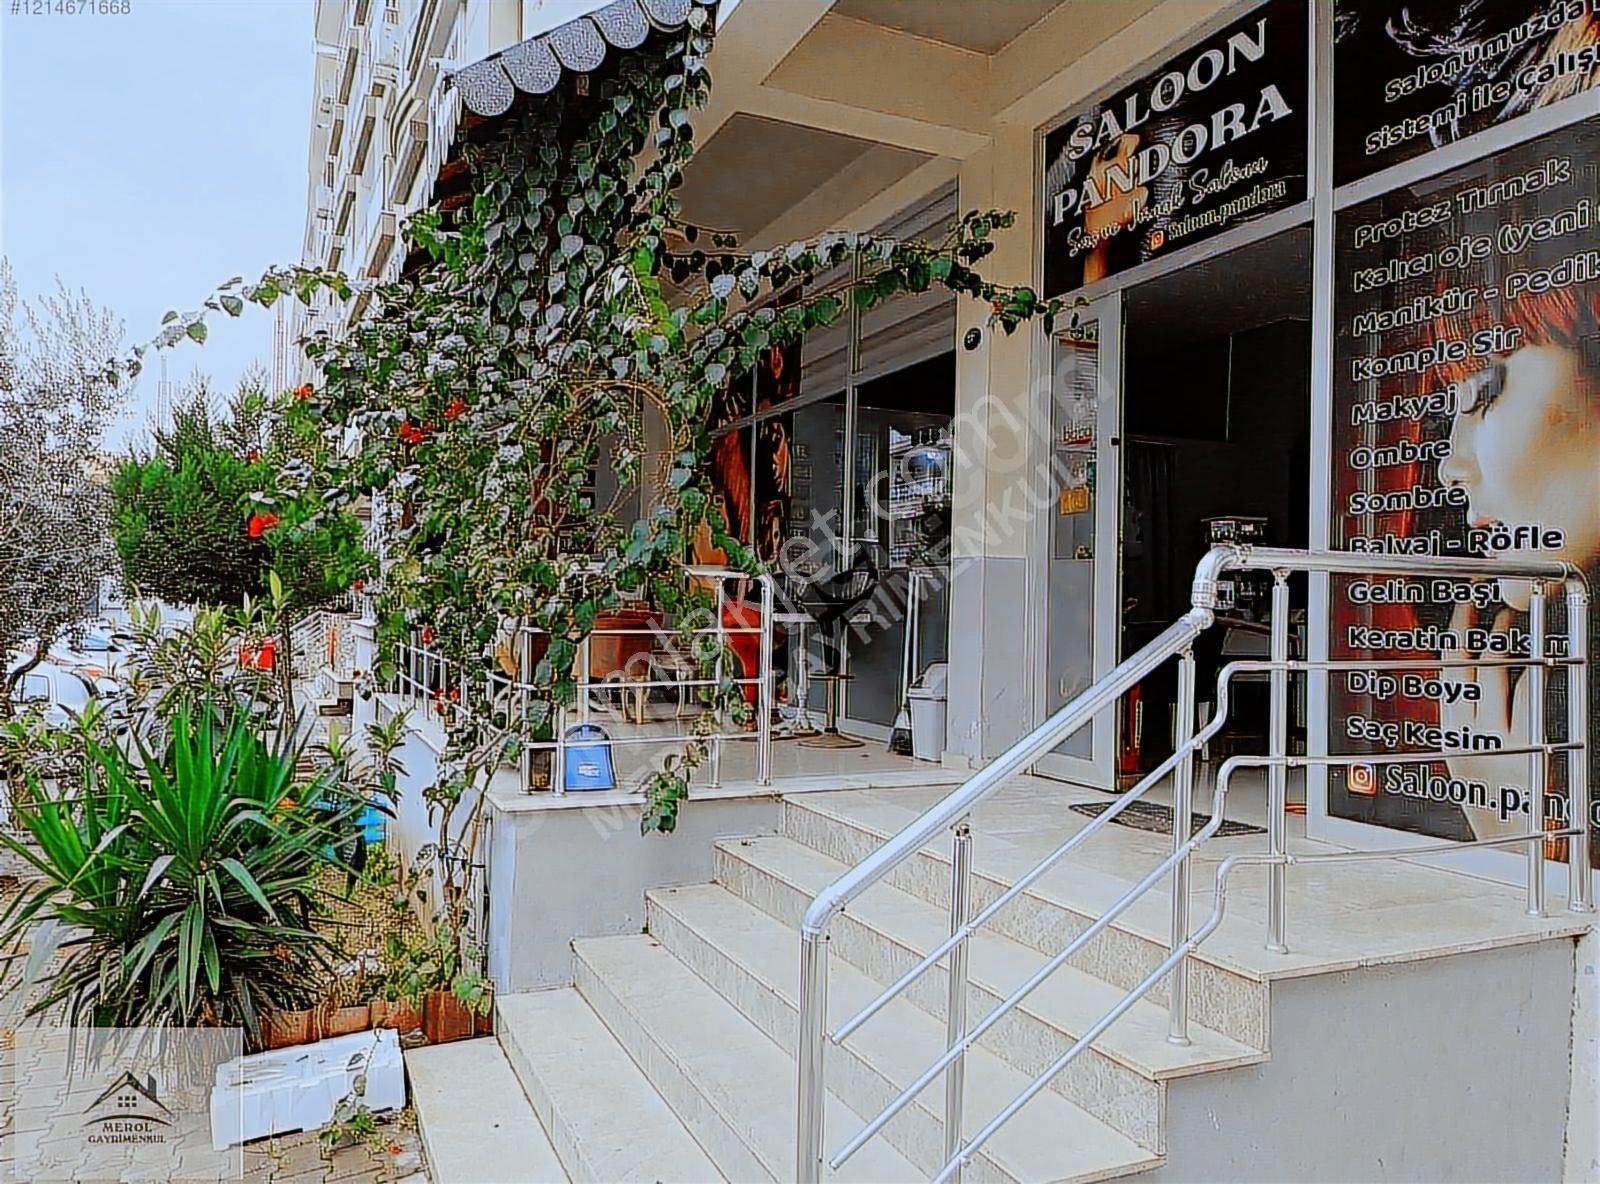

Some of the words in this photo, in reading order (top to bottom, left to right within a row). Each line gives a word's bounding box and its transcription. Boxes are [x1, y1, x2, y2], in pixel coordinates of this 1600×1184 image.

[1385, 0, 1585, 102] Salonumuzda
[1069, 18, 1267, 160] SALOON
[1366, 93, 1467, 155] Sistemi
[1472, 79, 1510, 111] ile
[1517, 42, 1600, 97] Çalış
[1053, 85, 1293, 226] PANDORA
[1355, 201, 1452, 248] Protez
[1457, 158, 1571, 214] Tırnak
[1354, 254, 1433, 293] Kalıcı
[1440, 236, 1491, 269] oje
[1497, 199, 1590, 254] (yeni
[1353, 287, 1478, 337] Manikür
[1353, 339, 1467, 381] Komple
[1351, 386, 1457, 425] Makyaj
[1350, 439, 1452, 470] Ombre
[1349, 485, 1468, 515] Sombre
[1467, 523, 1565, 553] Röfle
[1349, 580, 1425, 604] Gelin
[1348, 626, 1463, 651] Keratin
[1465, 628, 1570, 656] Bakm
[1347, 670, 1396, 700] Dip
[1402, 675, 1483, 703] Boya
[1346, 715, 1399, 746] Saç
[1404, 720, 1503, 750] Kesim
